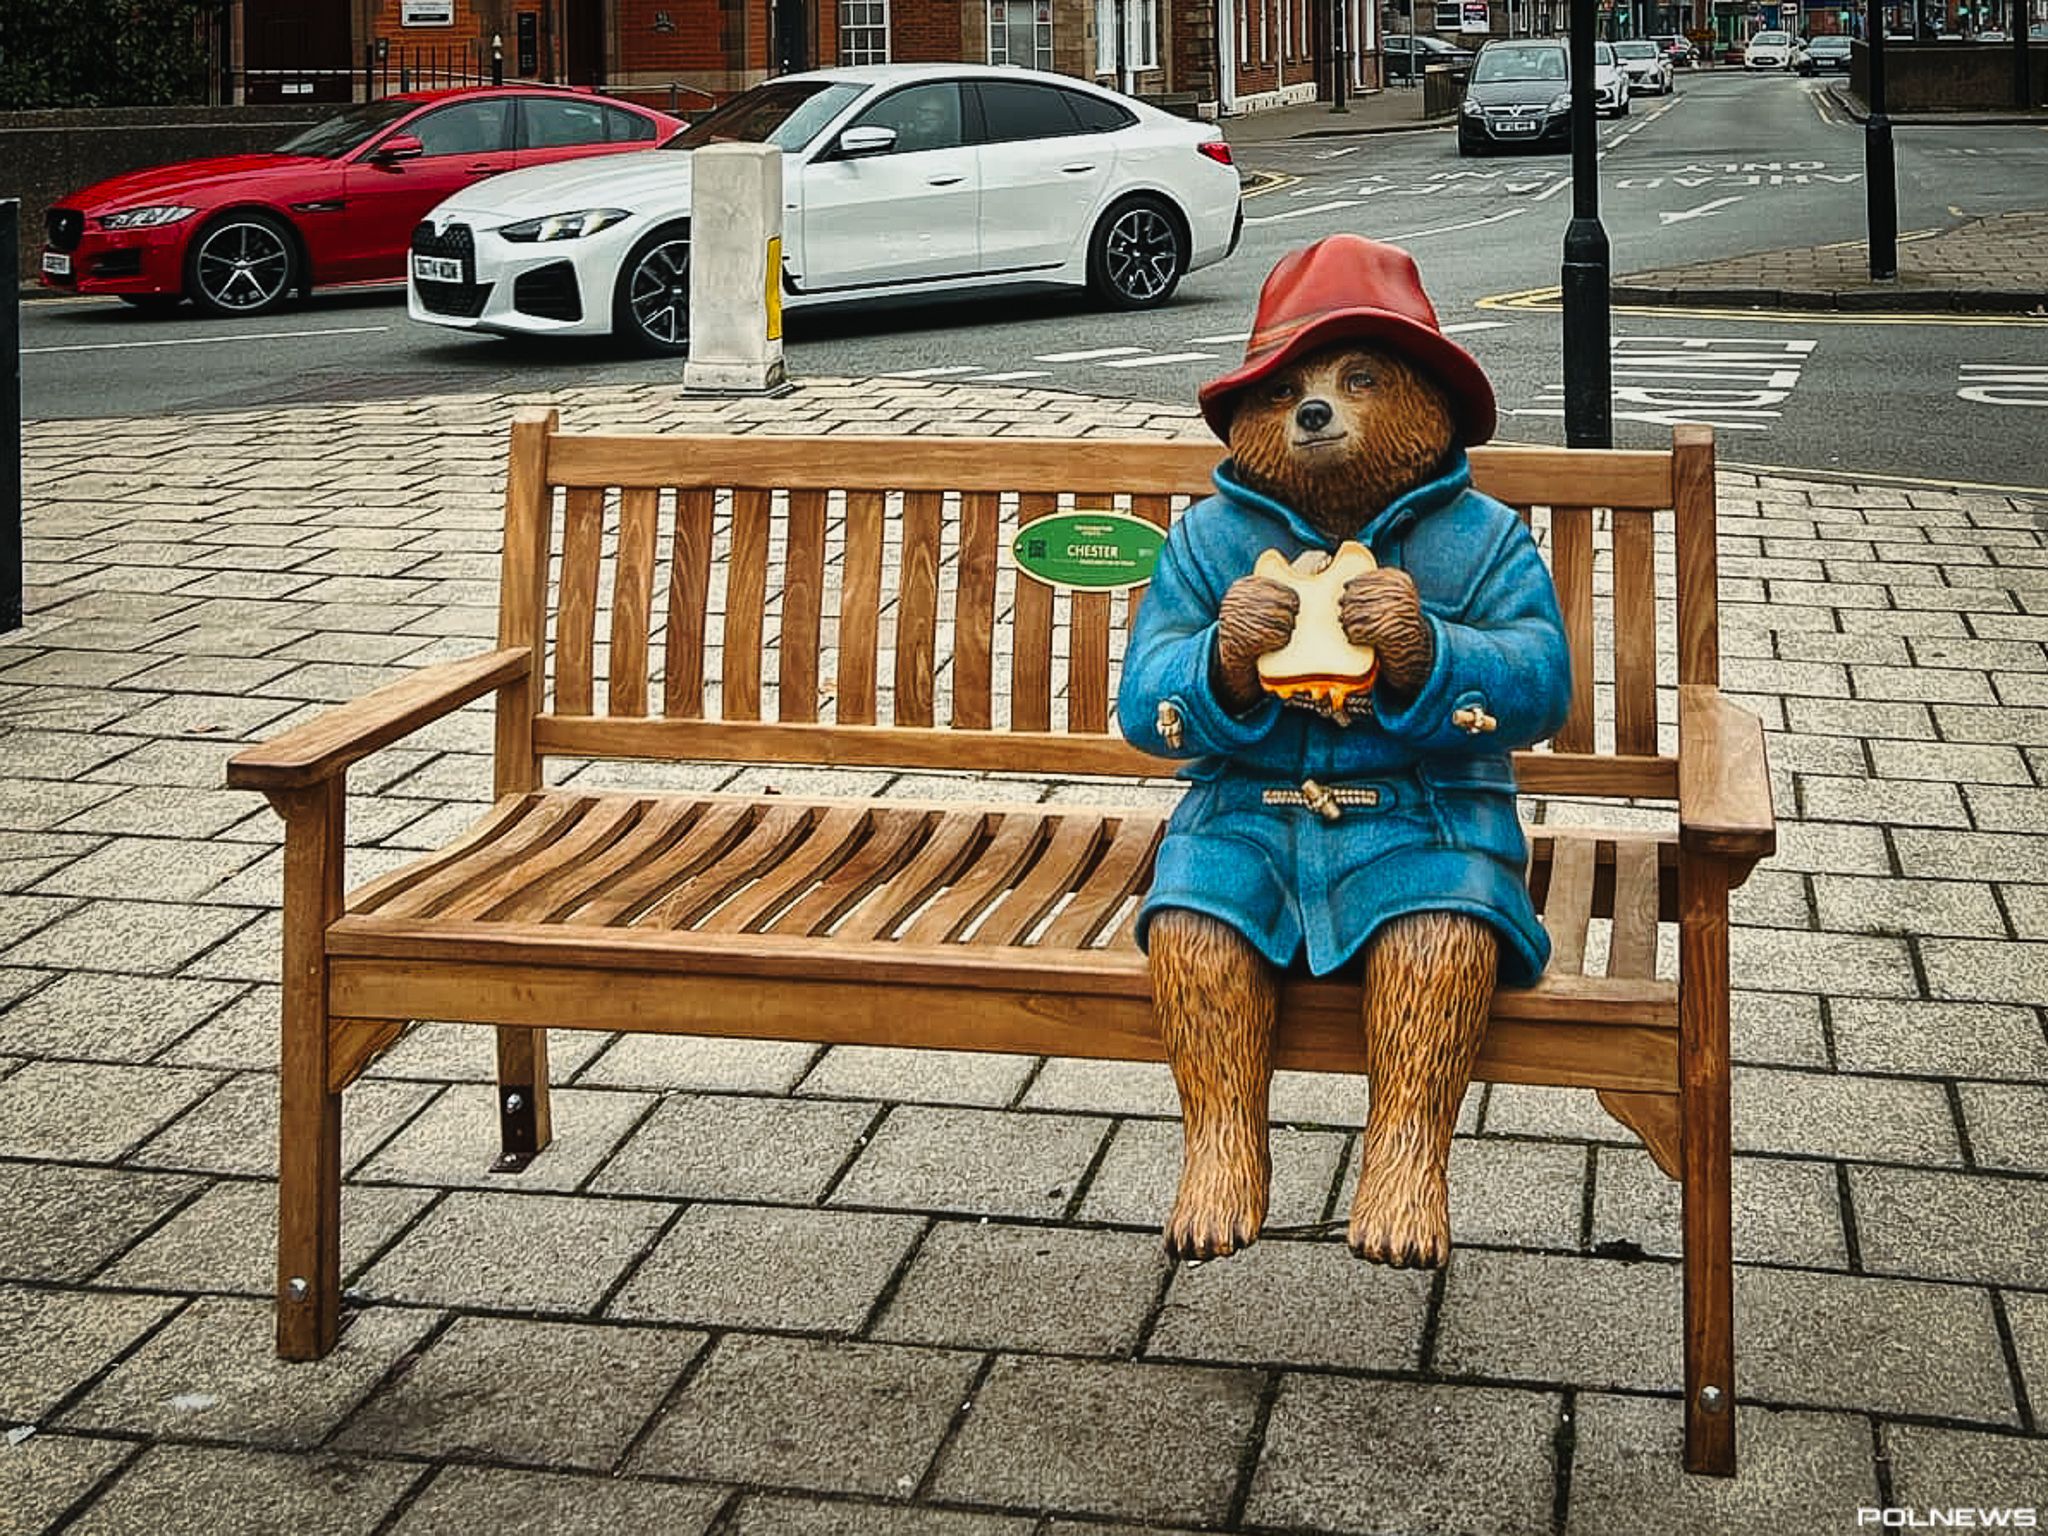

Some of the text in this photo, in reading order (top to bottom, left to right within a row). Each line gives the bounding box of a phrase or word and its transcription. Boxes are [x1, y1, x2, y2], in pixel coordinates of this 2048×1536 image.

[1670, 161, 1826, 174] ONLY
[1616, 173, 1865, 189] AHEAD
[1067, 544, 1119, 558] CHESTER
